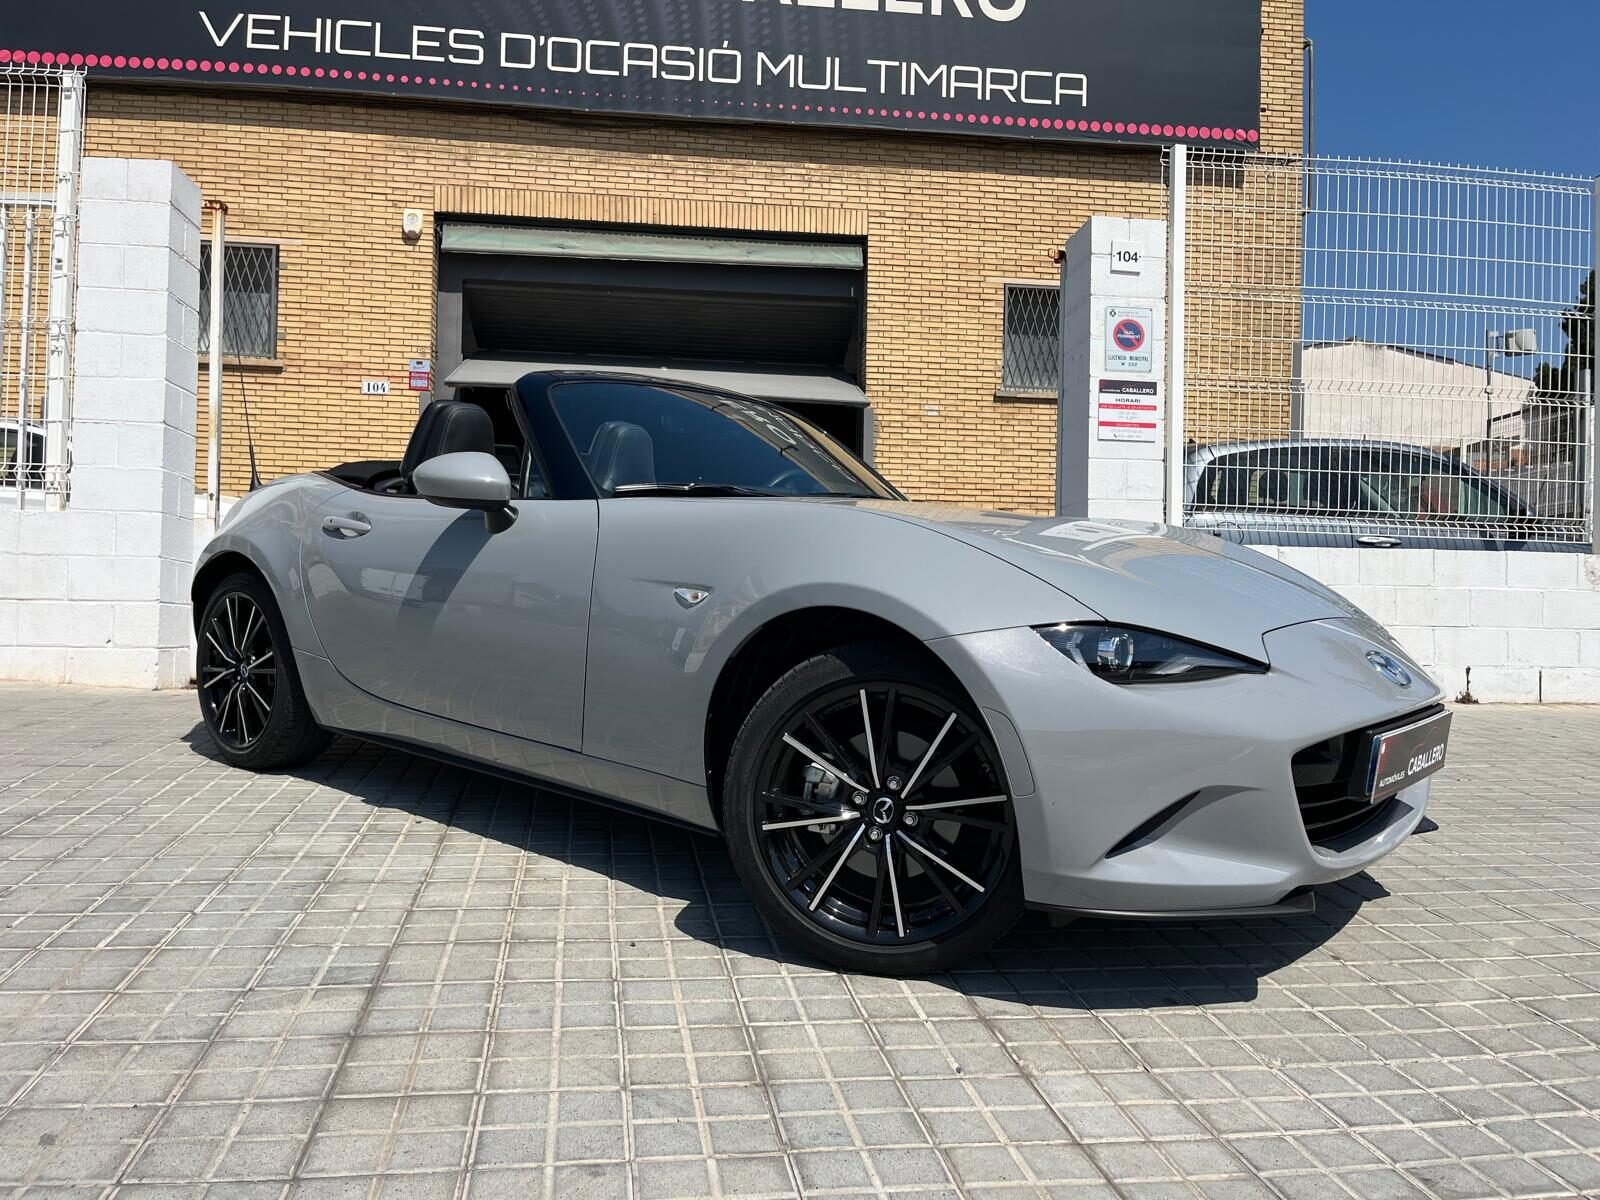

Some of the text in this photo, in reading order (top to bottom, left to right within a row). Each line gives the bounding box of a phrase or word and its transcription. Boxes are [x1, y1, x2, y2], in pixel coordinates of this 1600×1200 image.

[199, 11, 1088, 107] VEHICLES D'OCASIÓ MULTIMARCA
[367, 382, 386, 393] 104
[1407, 743, 1445, 775] CABALLERO
